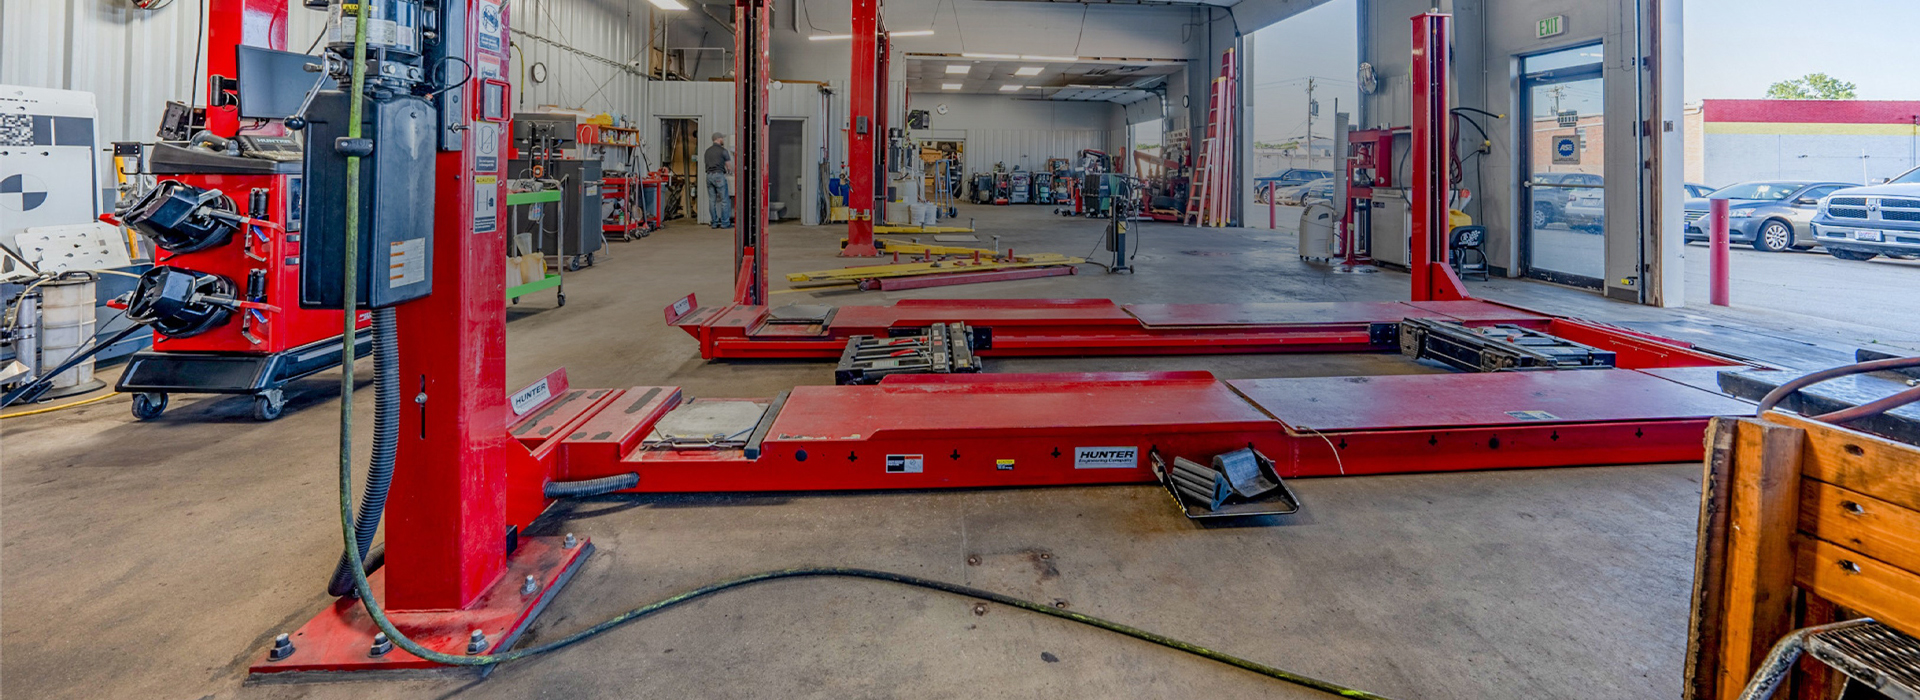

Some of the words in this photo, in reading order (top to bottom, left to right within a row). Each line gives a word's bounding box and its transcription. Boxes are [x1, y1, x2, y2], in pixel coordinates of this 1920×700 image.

[1540, 17, 1559, 36] EXIT
[515, 383, 546, 405] HUNTER
[1080, 451, 1134, 459] HUNTER
